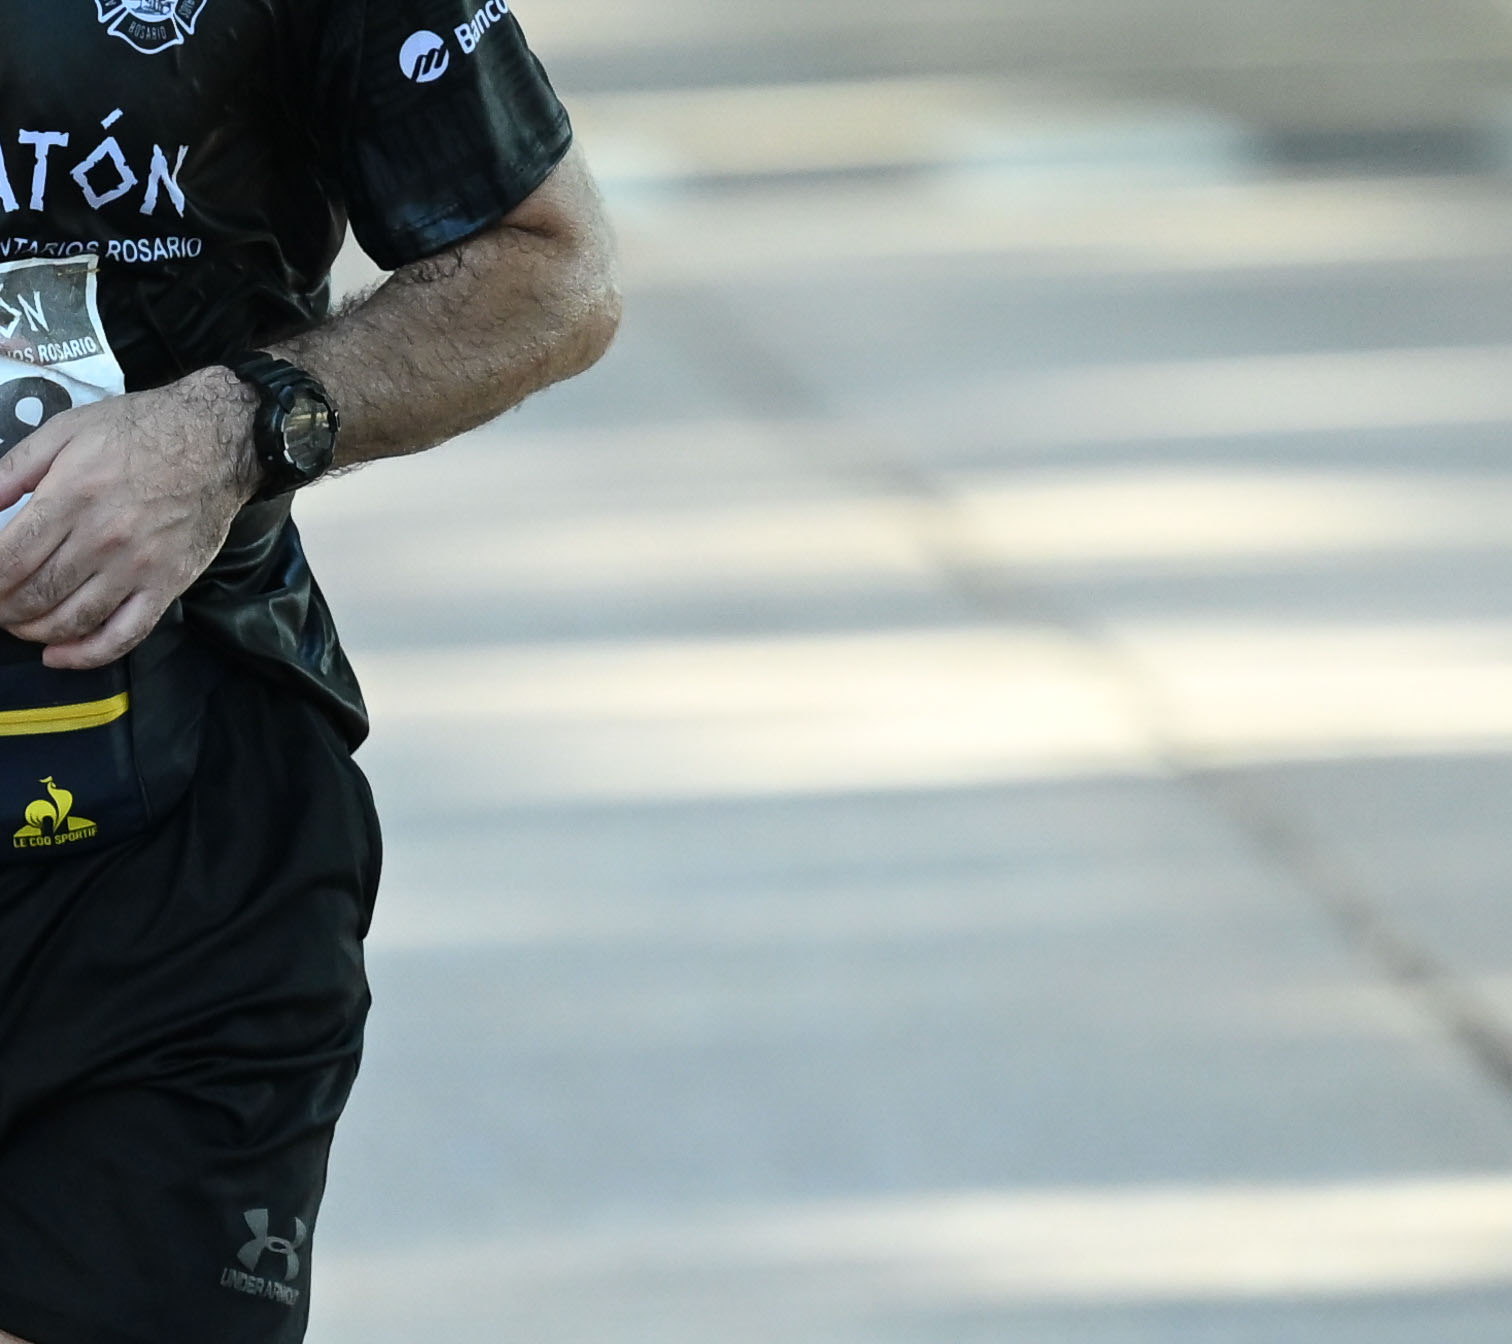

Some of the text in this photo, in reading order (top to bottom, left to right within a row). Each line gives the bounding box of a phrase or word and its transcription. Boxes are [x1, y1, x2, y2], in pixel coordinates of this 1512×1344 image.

[128, 20, 167, 41] ROSARIO
[106, 236, 202, 263] ROSARIO
[38, 335, 99, 364] ROSARIO
[13, 826, 98, 848] LE COQ SPORTIF
